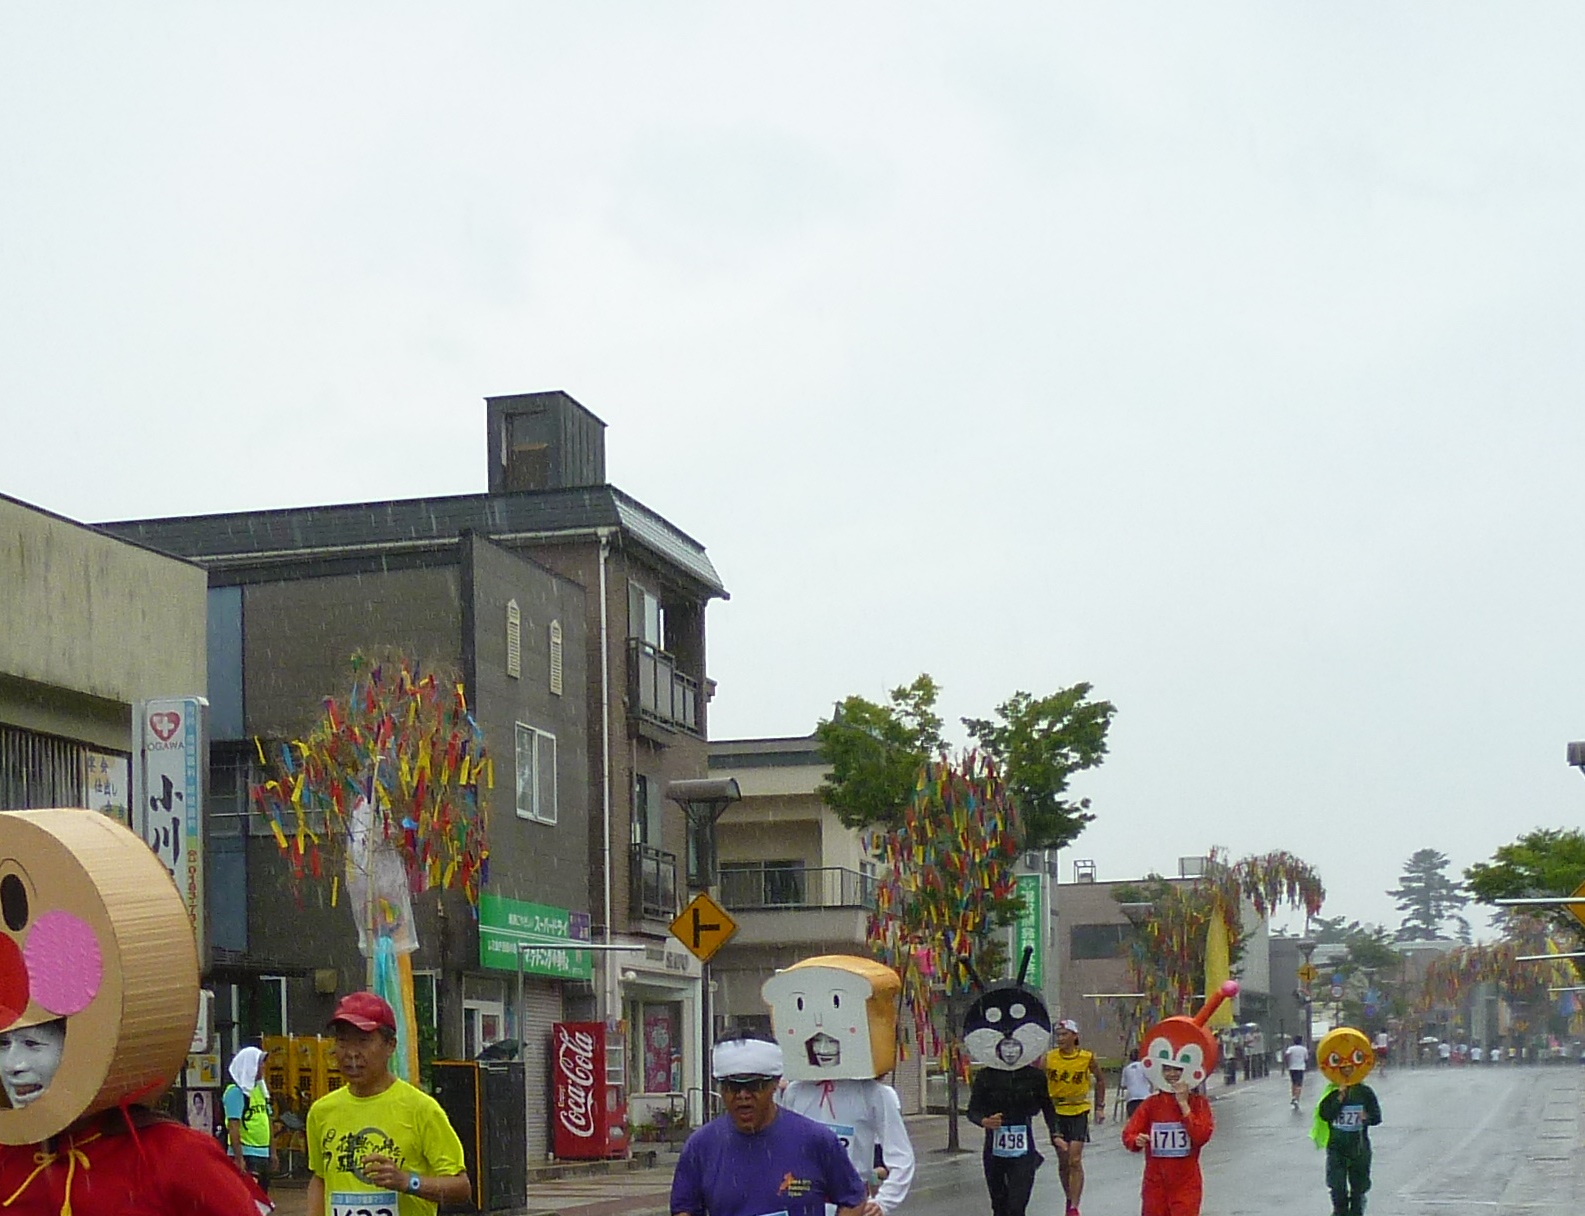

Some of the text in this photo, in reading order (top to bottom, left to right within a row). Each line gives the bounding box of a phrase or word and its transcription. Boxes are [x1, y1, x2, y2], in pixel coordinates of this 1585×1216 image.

[147, 741, 186, 752] OGAWA
[149, 774, 184, 877] 小川
[559, 1025, 594, 1138] Coca-Cola
[1154, 1130, 1188, 1149] 1713
